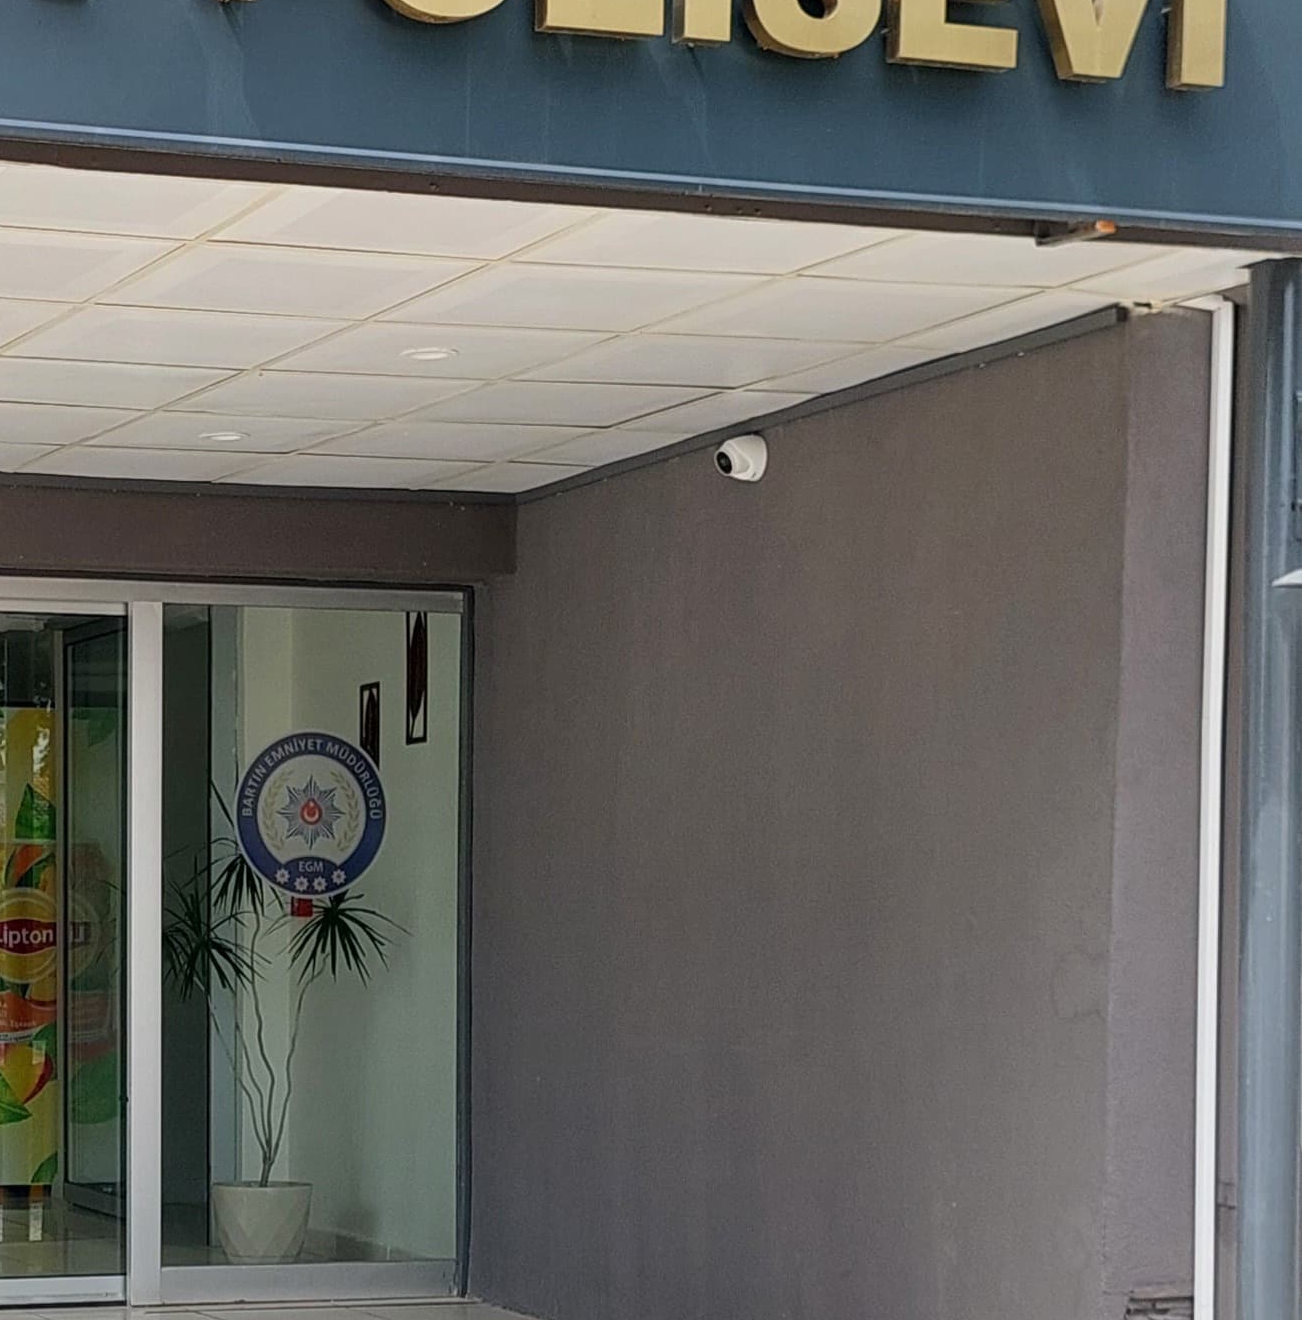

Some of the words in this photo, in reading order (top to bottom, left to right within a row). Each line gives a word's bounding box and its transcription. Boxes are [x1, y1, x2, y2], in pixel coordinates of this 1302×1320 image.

[241, 764, 268, 818] BARTIN
[264, 737, 324, 768] EMNİYET
[325, 741, 383, 820] MÜDÜRLÜĞÜ
[298, 861, 324, 873] EGM
